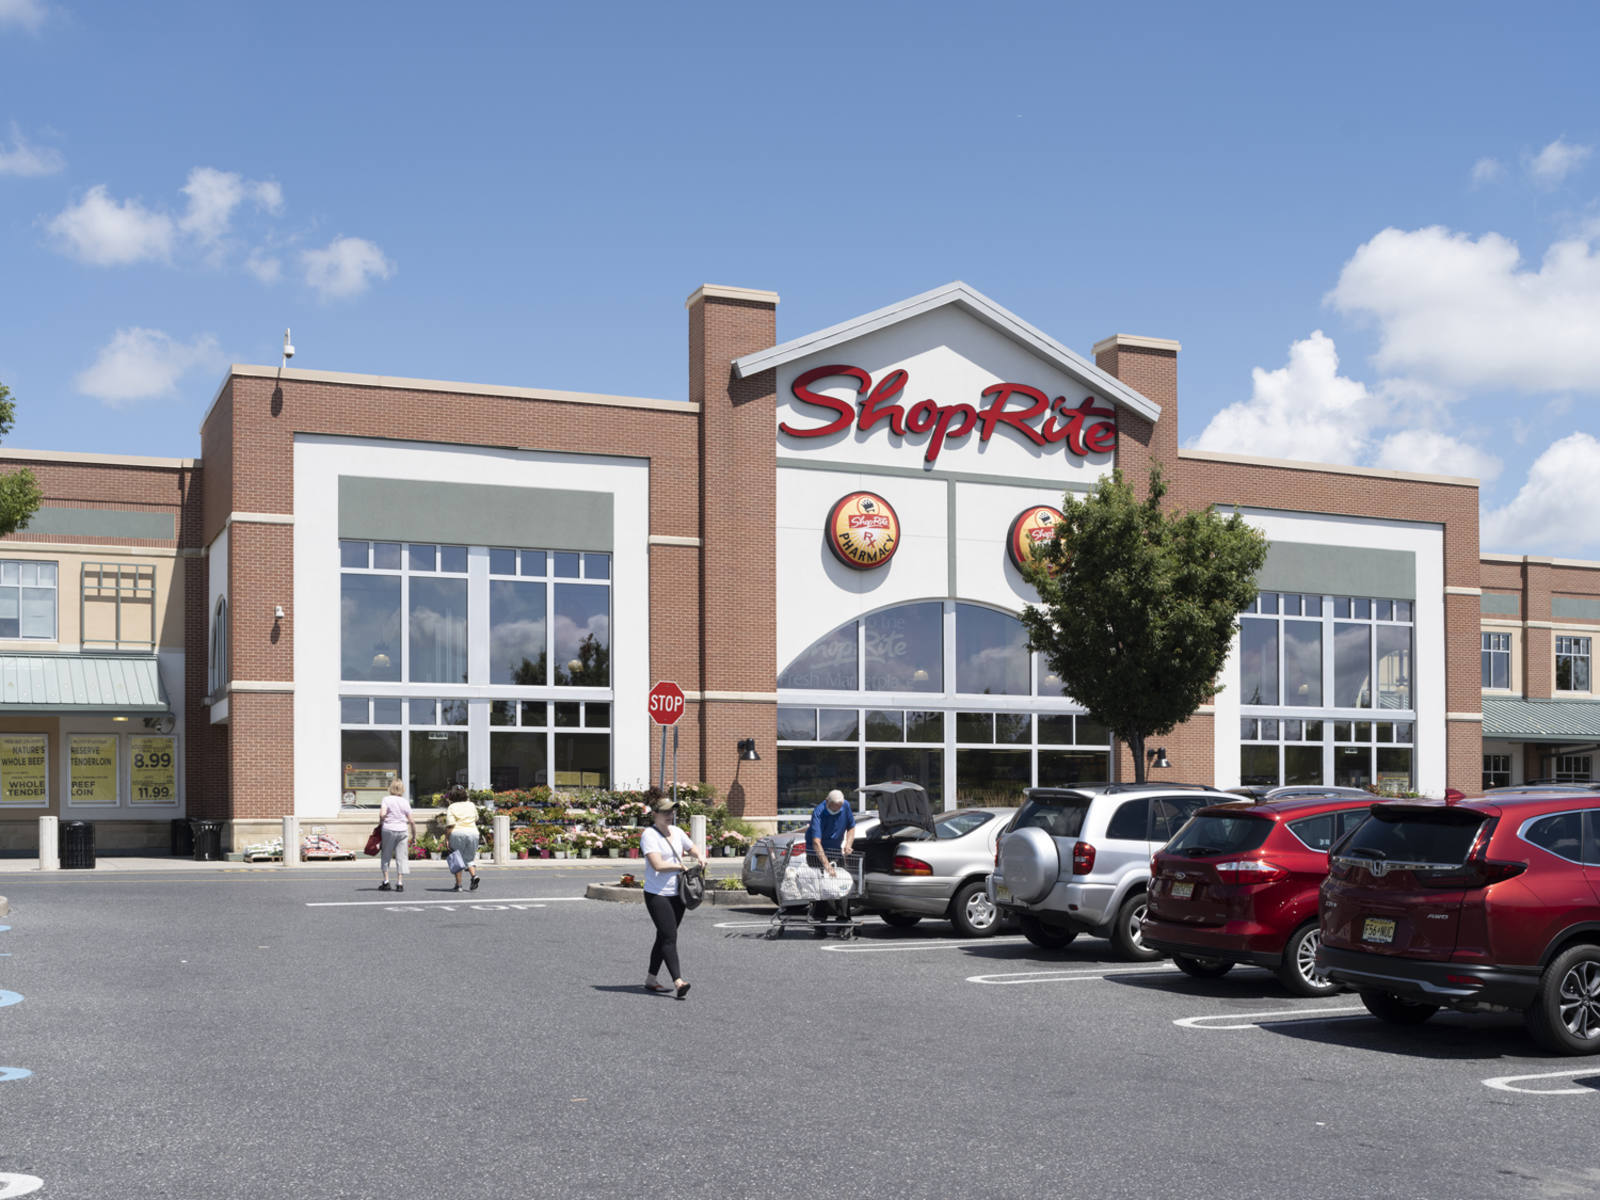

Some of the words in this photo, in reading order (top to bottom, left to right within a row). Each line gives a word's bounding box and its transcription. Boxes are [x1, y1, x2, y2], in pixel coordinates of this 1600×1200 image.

[779, 364, 1117, 462] ShopRite
[851, 515, 889, 528] ShopRite
[839, 532, 894, 562] PHARMACY
[650, 694, 683, 712] STOP
[1, 757, 26, 766] WHOLE
[71, 757, 112, 766] TENDERLOIN
[134, 752, 172, 768] 8.99
[8, 780, 46, 788] WHOLE
[7, 788, 46, 797] TENDER
[71, 788, 94, 797] LOIN
[138, 786, 170, 798] 11.99
